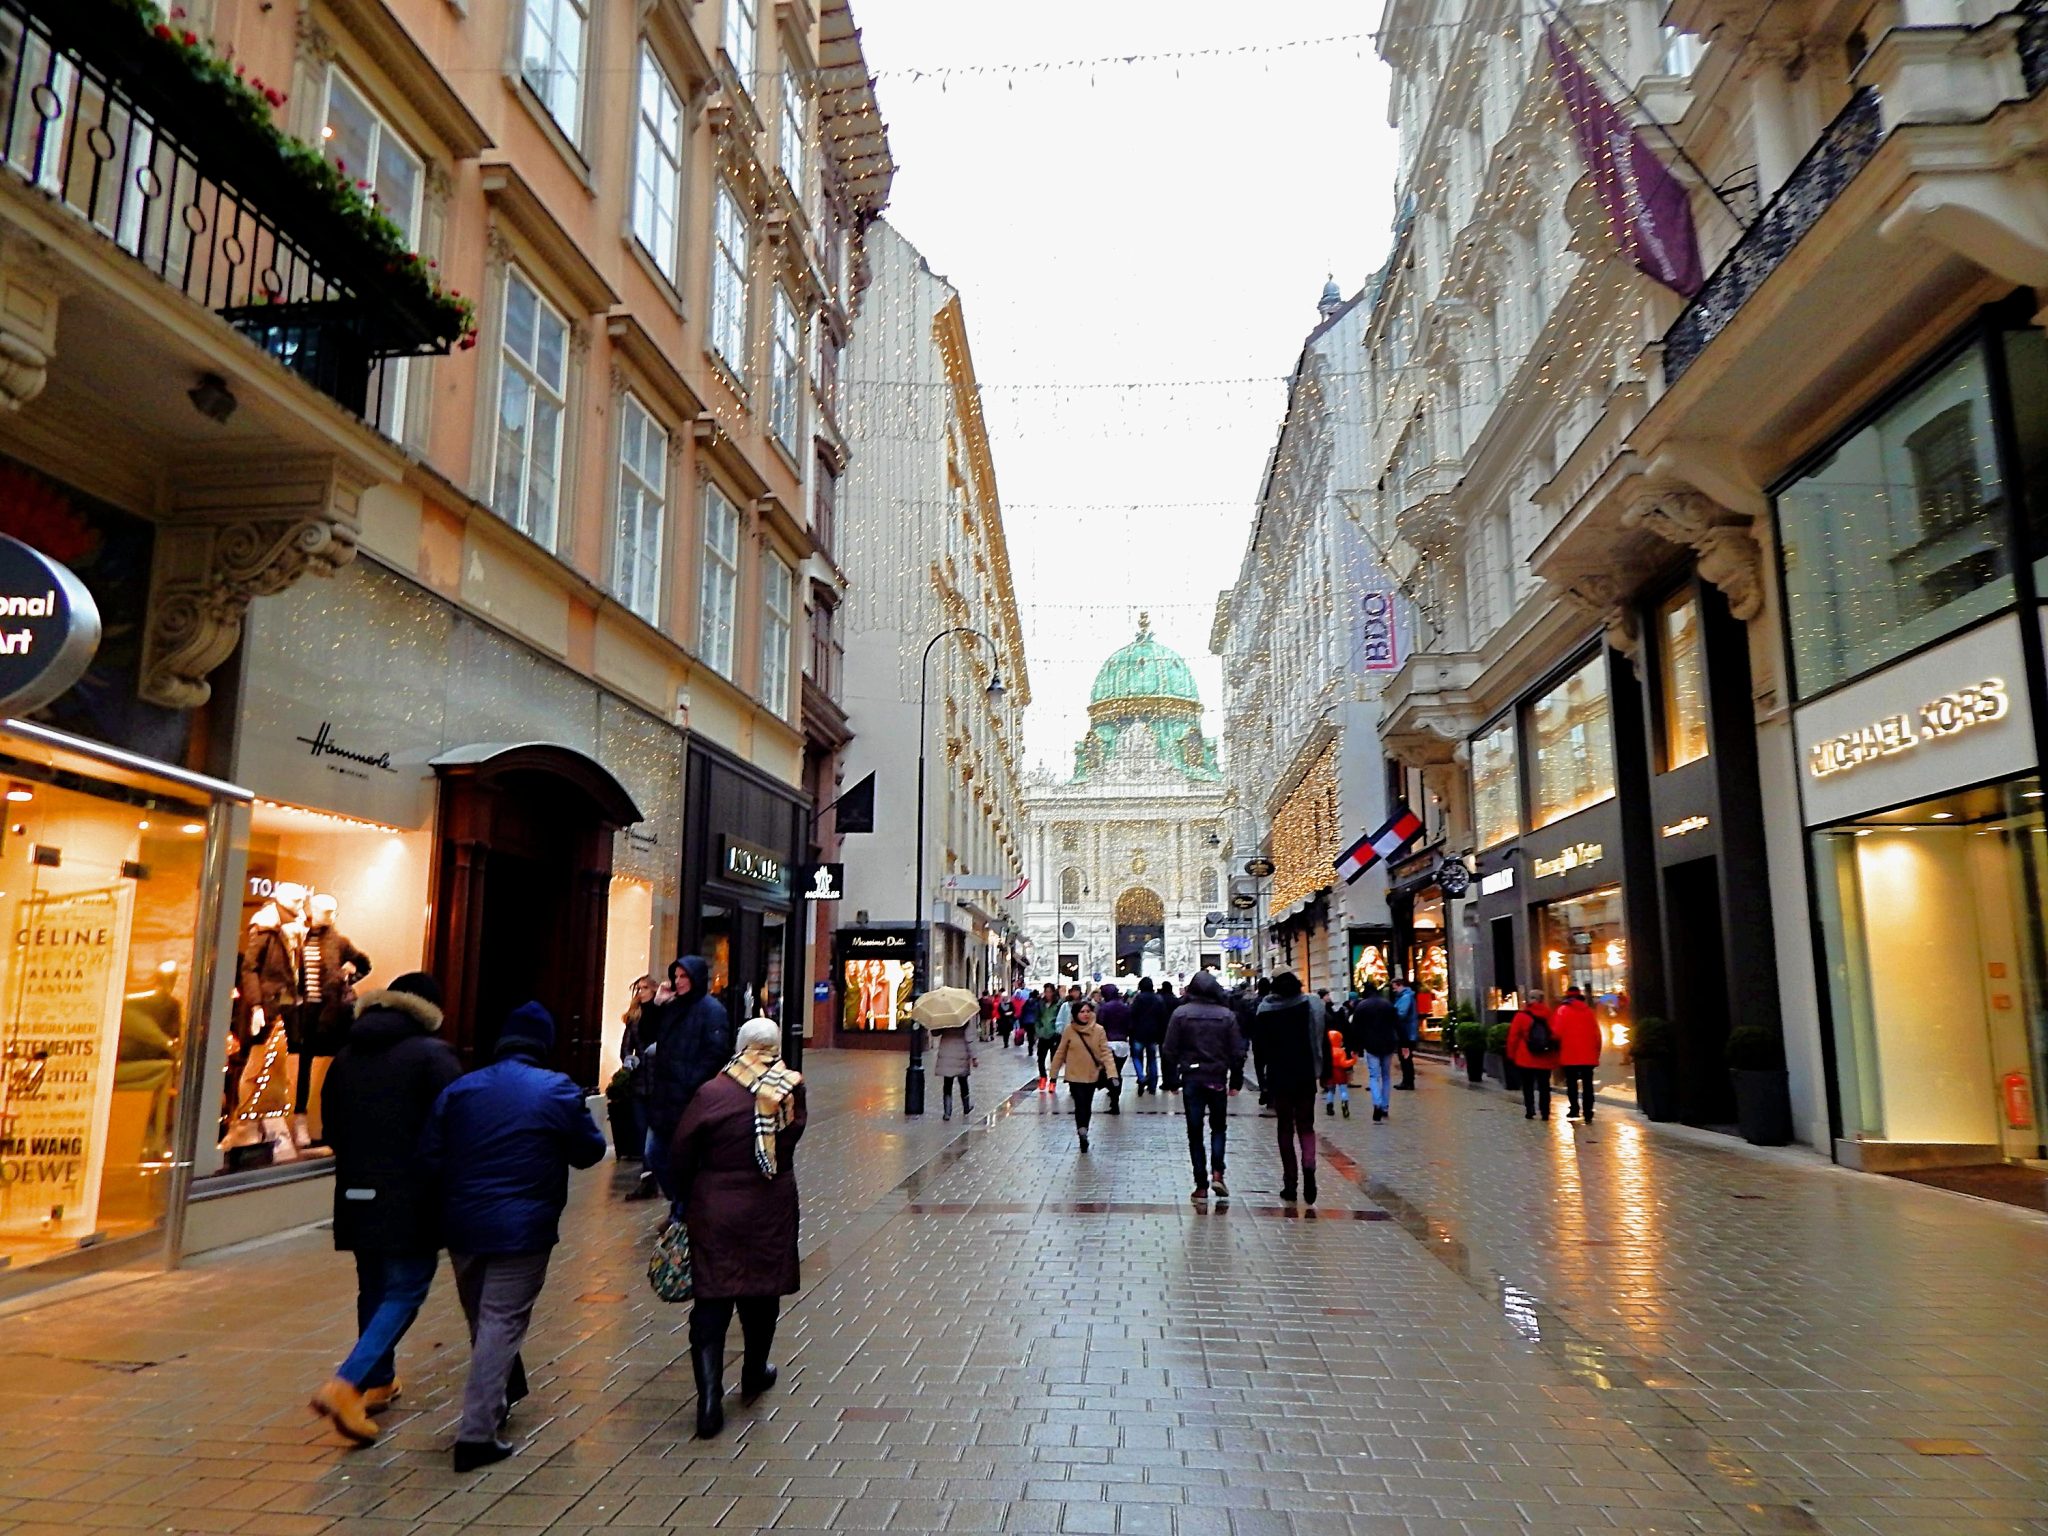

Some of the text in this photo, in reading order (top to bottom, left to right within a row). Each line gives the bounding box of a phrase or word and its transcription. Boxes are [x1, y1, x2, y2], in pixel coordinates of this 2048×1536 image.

[1362, 592, 1390, 660] BDO
[1919, 677, 2009, 740] KORS
[16, 924, 107, 946] CÉLINE
[31, 1137, 82, 1155] WANG
